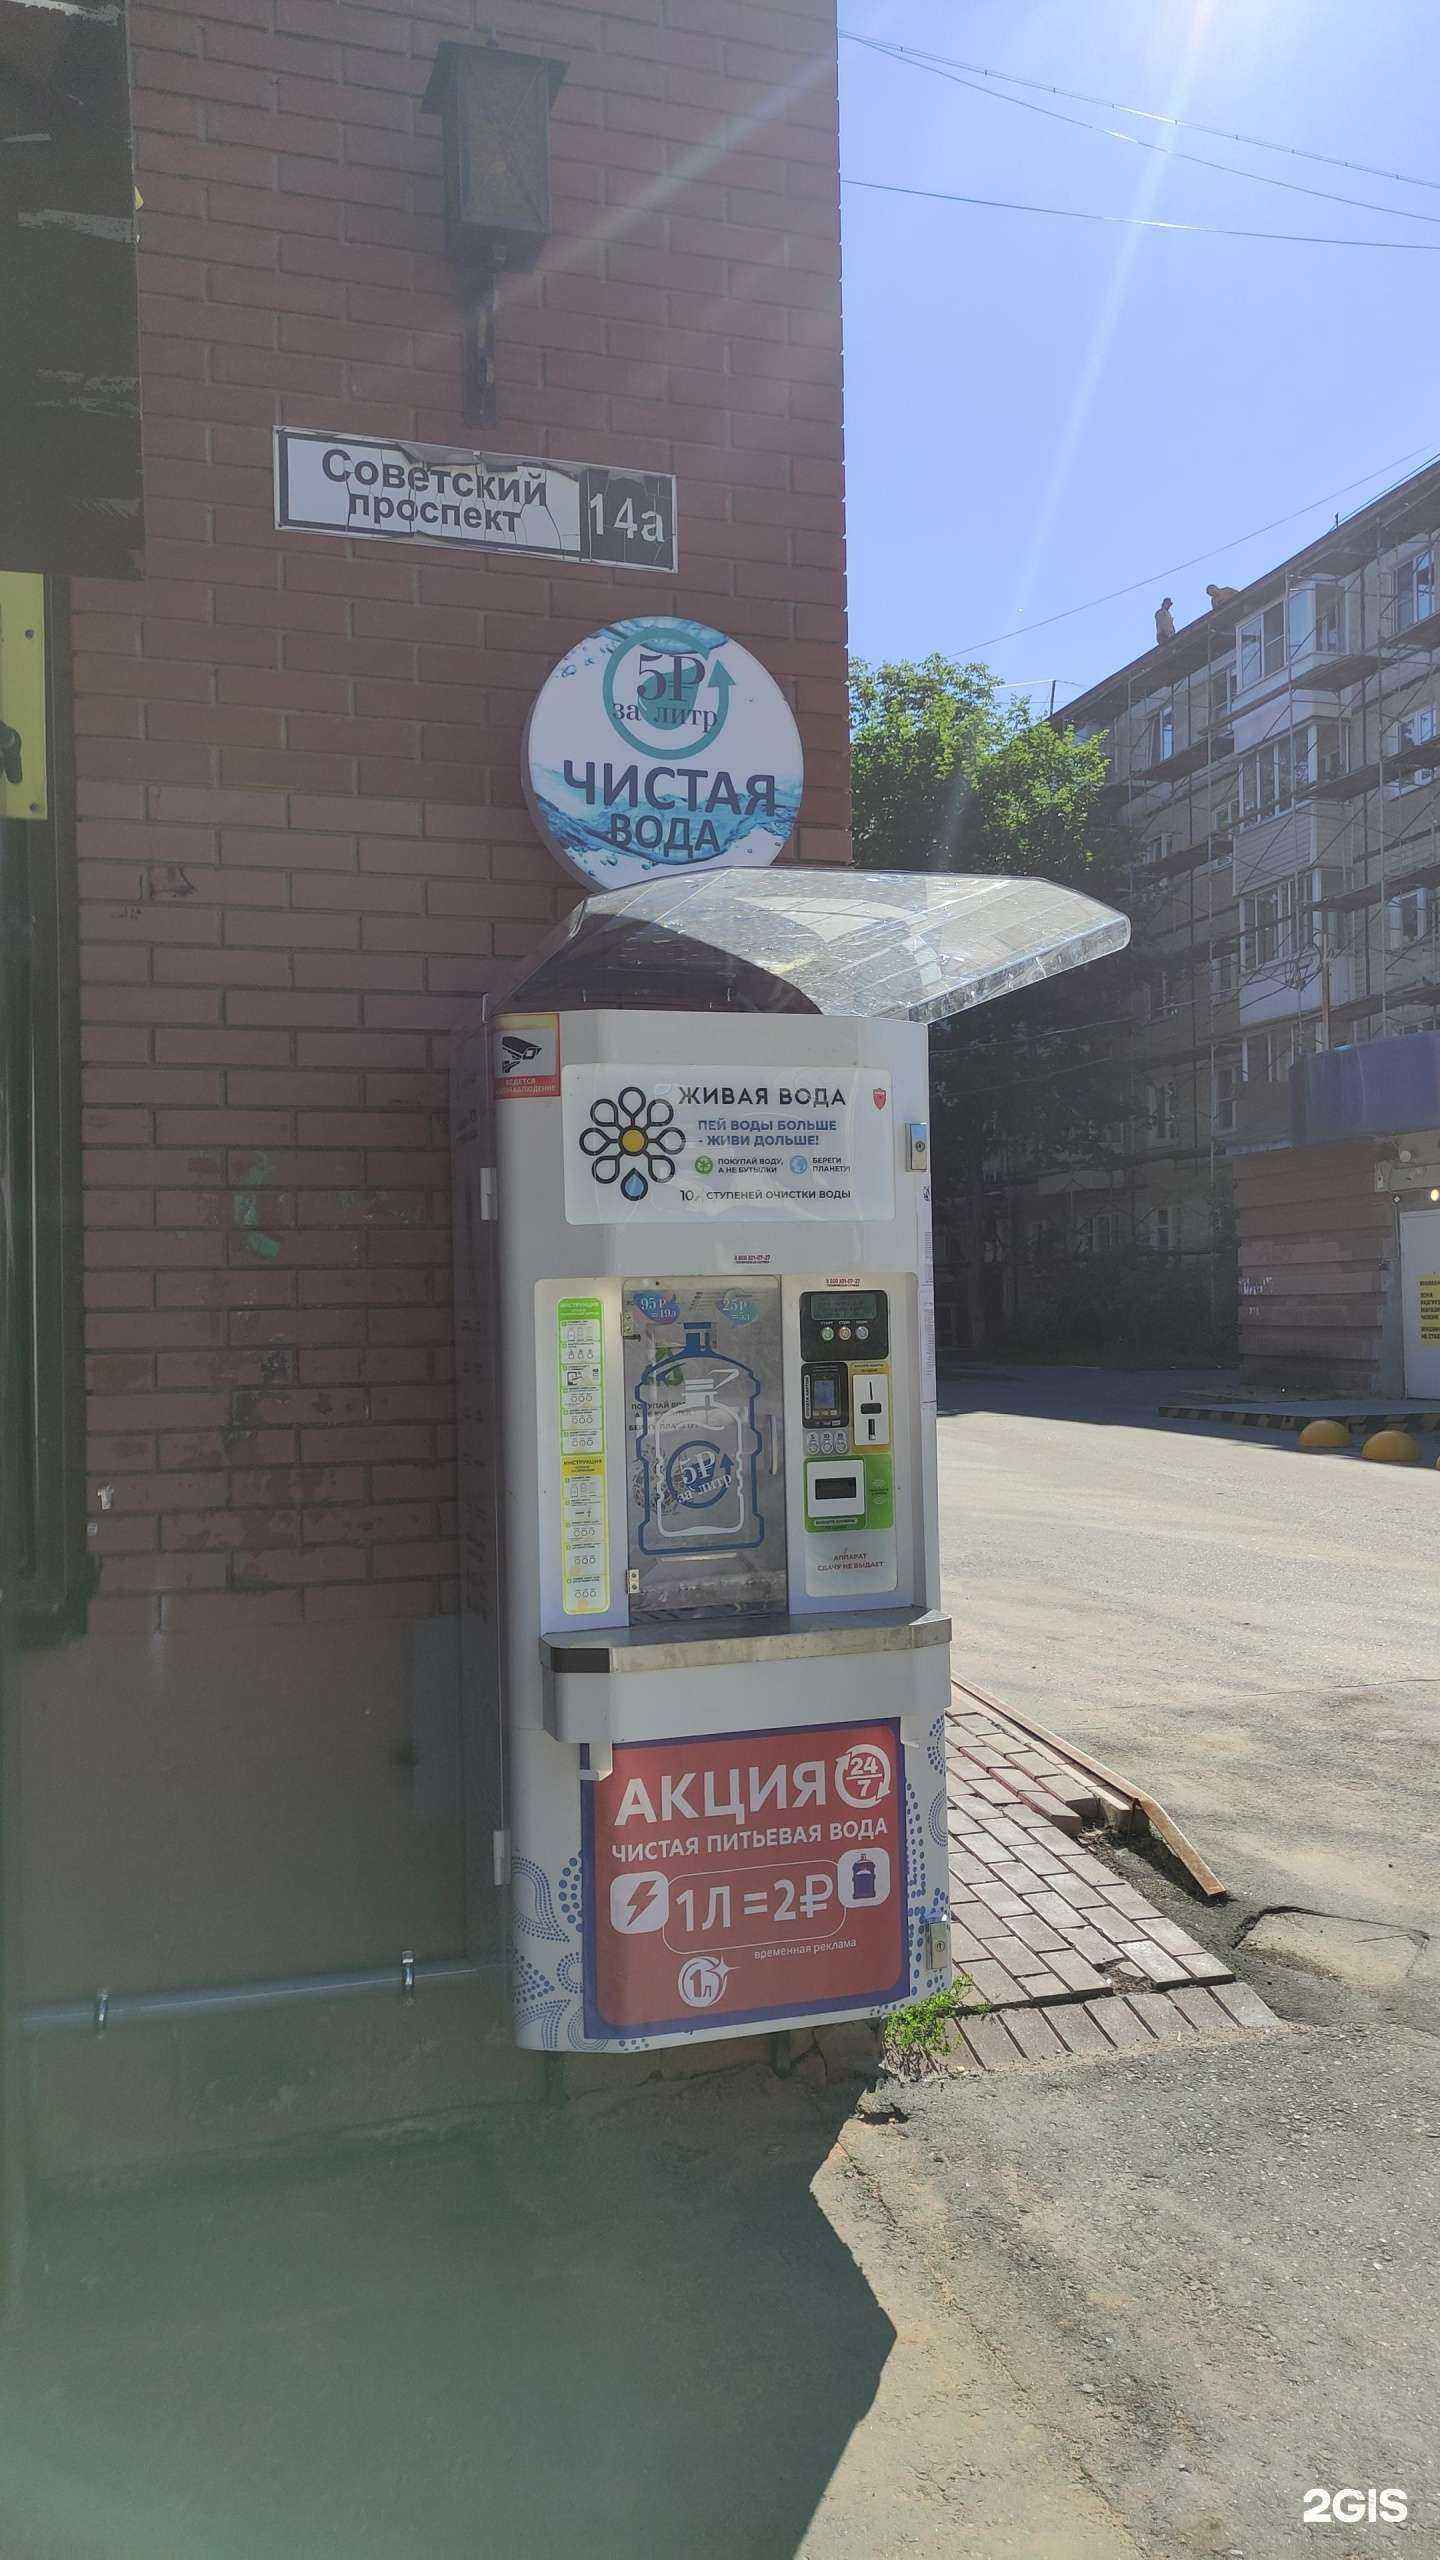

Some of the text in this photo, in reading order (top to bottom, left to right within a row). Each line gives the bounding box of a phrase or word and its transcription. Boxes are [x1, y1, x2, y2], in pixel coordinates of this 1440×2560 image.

[321, 448, 547, 507] Советский
[348, 494, 521, 533] проспект
[591, 493, 665, 543] 14а
[612, 703, 718, 733] за литр
[563, 760, 775, 816] ЧИСТАЯ
[611, 813, 721, 859] ВОДА
[679, 1087, 846, 1108] ЖИВАЯ ВОДА
[698, 1119, 837, 1132] ПЕЙ ВОДЫ БОЛЬШЕ
[707, 1135, 750, 1146] ЖИВИ
[754, 1135, 819, 1147] ДОЛЬШЕ!
[718, 1157, 758, 1165] ПОКУПАЙ
[706, 1189, 762, 1200] СТУПЕНЕЙ
[766, 1190, 815, 1199] ОЧИСТКИ
[819, 1189, 851, 1199] ВОДЫ
[817, 1563, 841, 1571] СДАЧУ
[854, 1561, 883, 1569] ВЫДАЕТ
[833, 1553, 867, 1561] АППАРАТ
[850, 1756, 878, 1775] 24
[614, 1760, 826, 1826] АКЦИЯ
[857, 1779, 869, 1797] 7
[612, 1818, 888, 1863] ЧИСТАЯ ПИТЬЕВАЯ ВОДА
[754, 1938, 856, 1960] временная реклама
